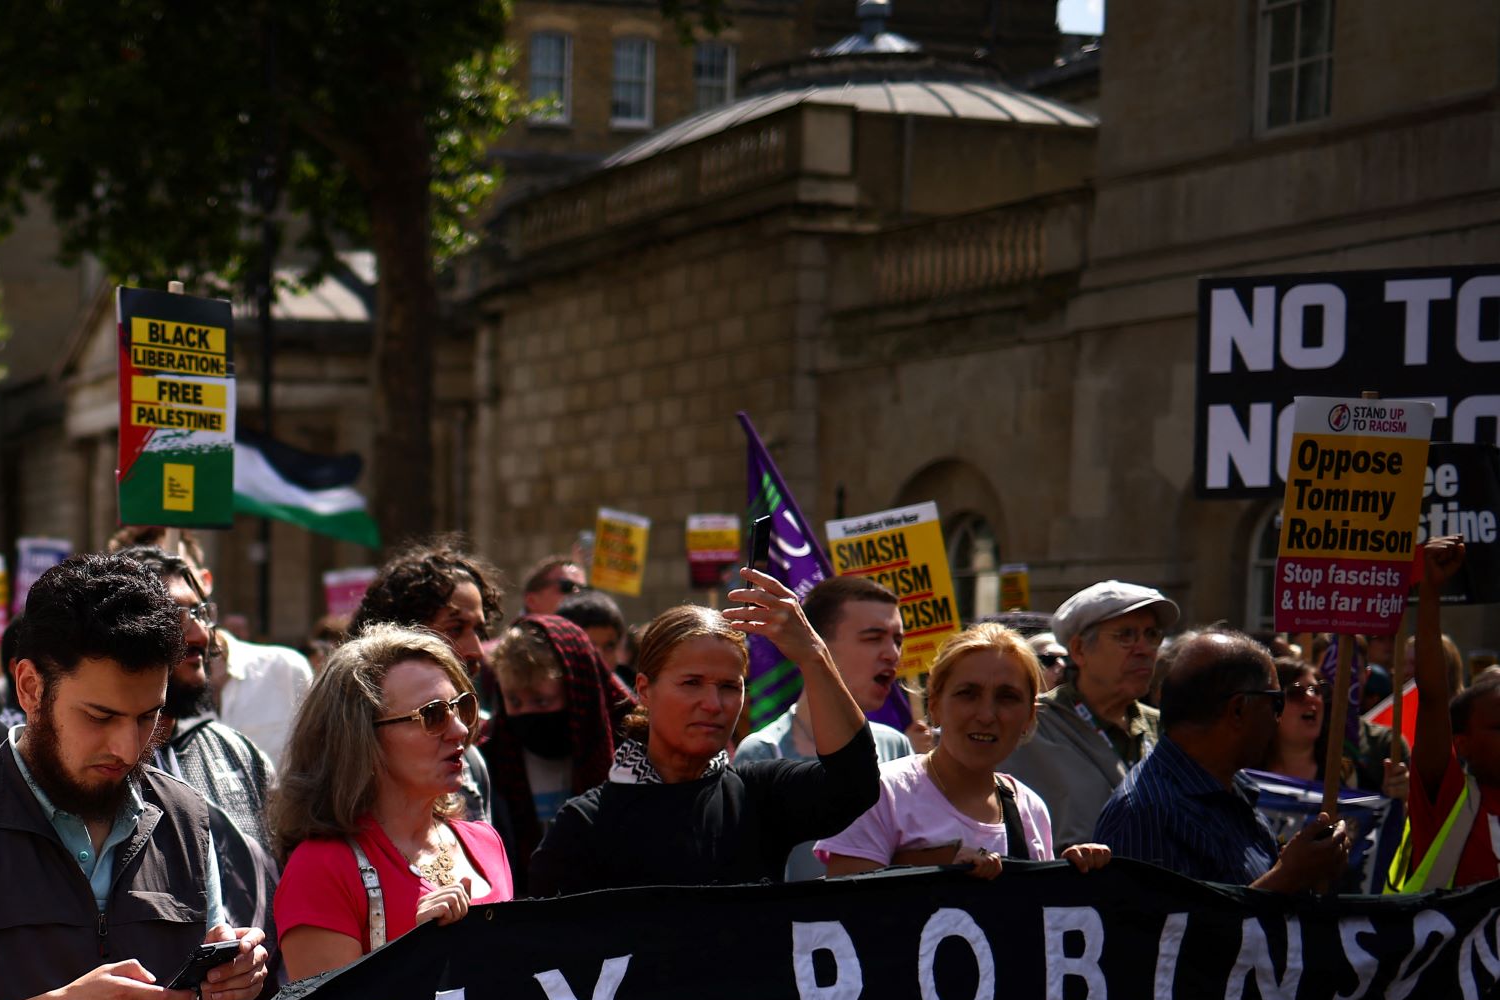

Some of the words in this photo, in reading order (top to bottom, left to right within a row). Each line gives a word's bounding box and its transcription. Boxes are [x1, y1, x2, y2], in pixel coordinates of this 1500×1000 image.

[148, 321, 211, 350] BLACK
[1208, 283, 1347, 374] NO
[133, 348, 225, 375] LIBERATION:
[157, 380, 203, 405] FREE
[136, 406, 222, 431] PALESTINE!
[1352, 419, 1367, 431] TO
[1368, 420, 1407, 433] RACISM
[1353, 406, 1387, 420] STAND
[1389, 408, 1405, 421] UP
[1206, 401, 1295, 490] N
[1297, 439, 1403, 480] Oppose
[1294, 478, 1396, 521] Tommy
[1287, 517, 1413, 554] Robinson
[836, 532, 909, 570] SMASH
[1283, 562, 1323, 588] Stop
[1327, 564, 1401, 587] fascists
[902, 597, 954, 631] CISM
[1280, 589, 1293, 610] &
[1297, 590, 1326, 611] the
[1330, 591, 1362, 613] far
[1366, 593, 1404, 618] right
